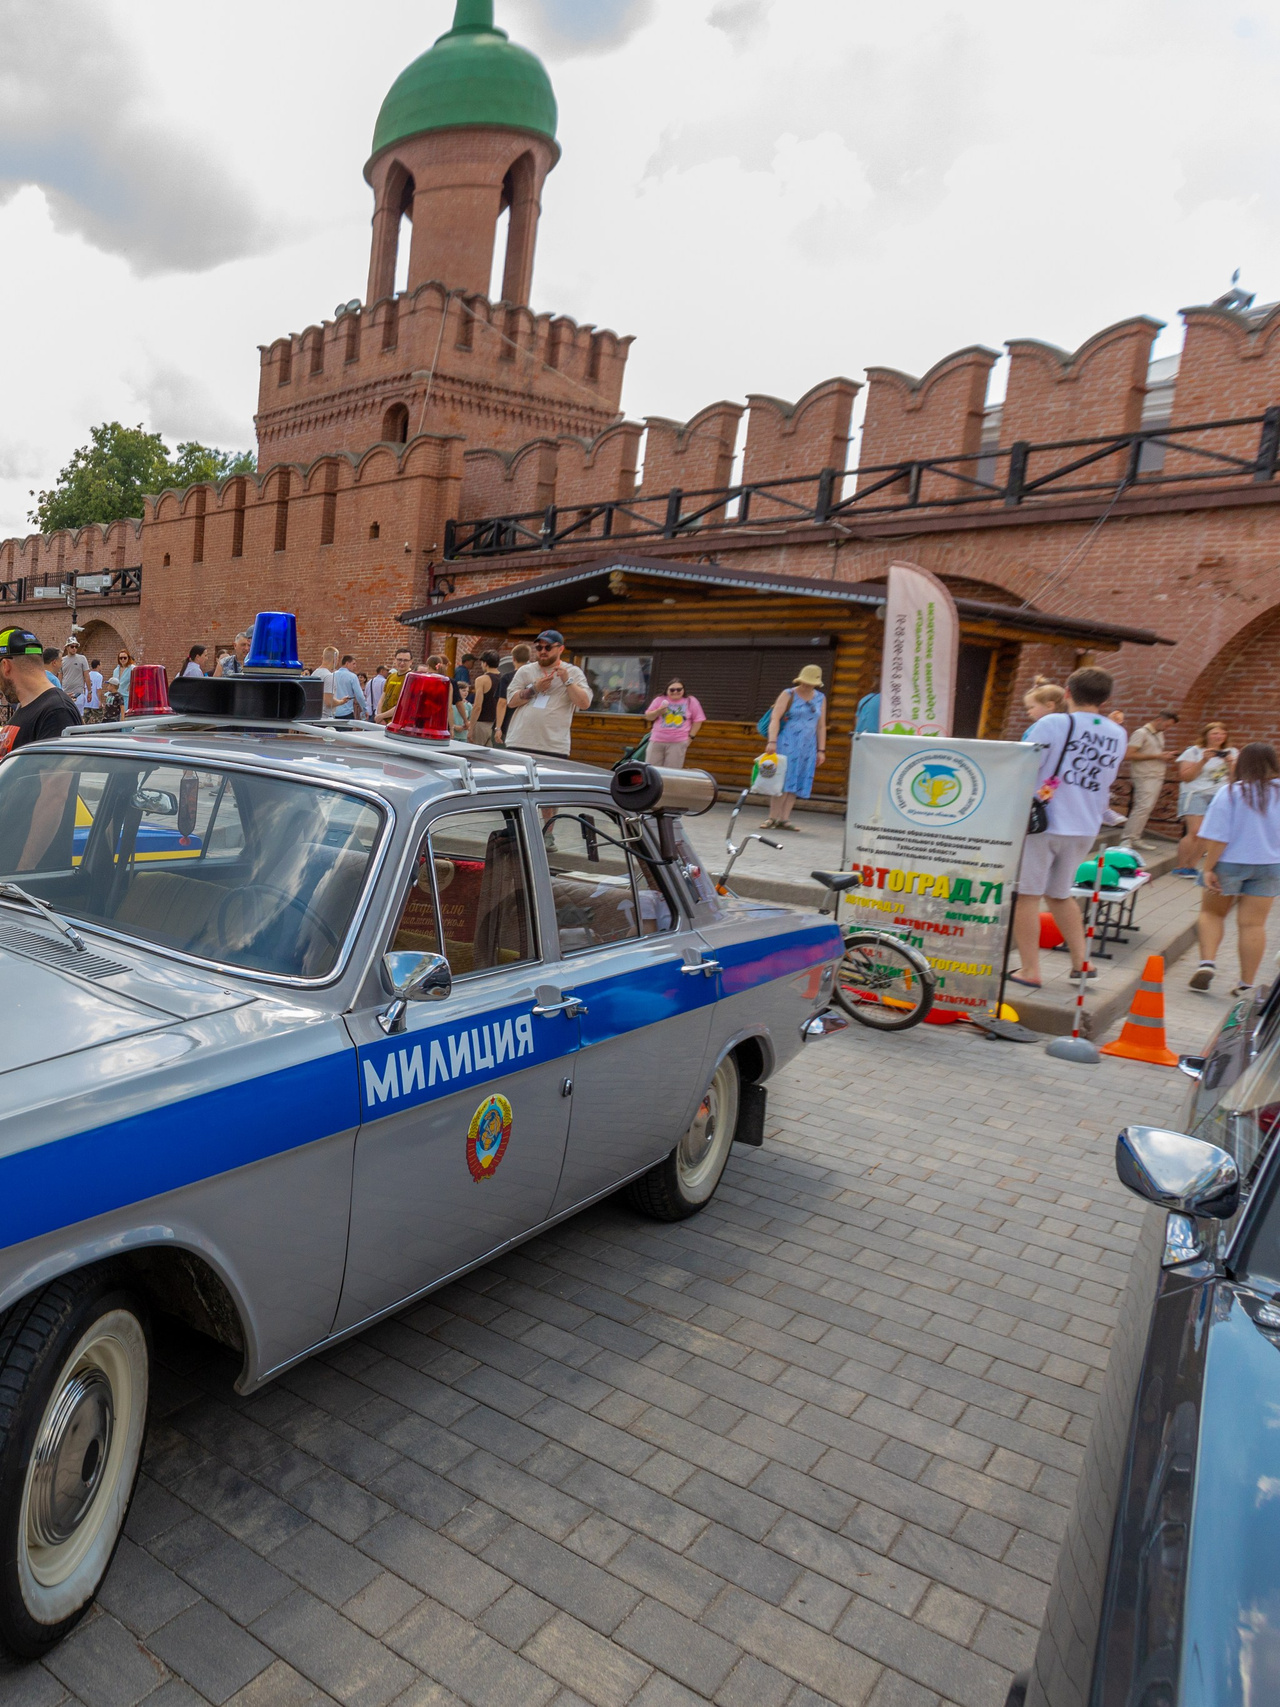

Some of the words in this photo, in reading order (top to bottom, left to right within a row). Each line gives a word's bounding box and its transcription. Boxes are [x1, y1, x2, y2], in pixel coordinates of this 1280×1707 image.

[1080, 730, 1119, 753] ANTI
[1065, 740, 1119, 769] STOCK
[1063, 770, 1100, 792] CLUB
[925, 956, 993, 977] ТОГРАД.71
[362, 1013, 535, 1107] МИЛИЦИЯ
